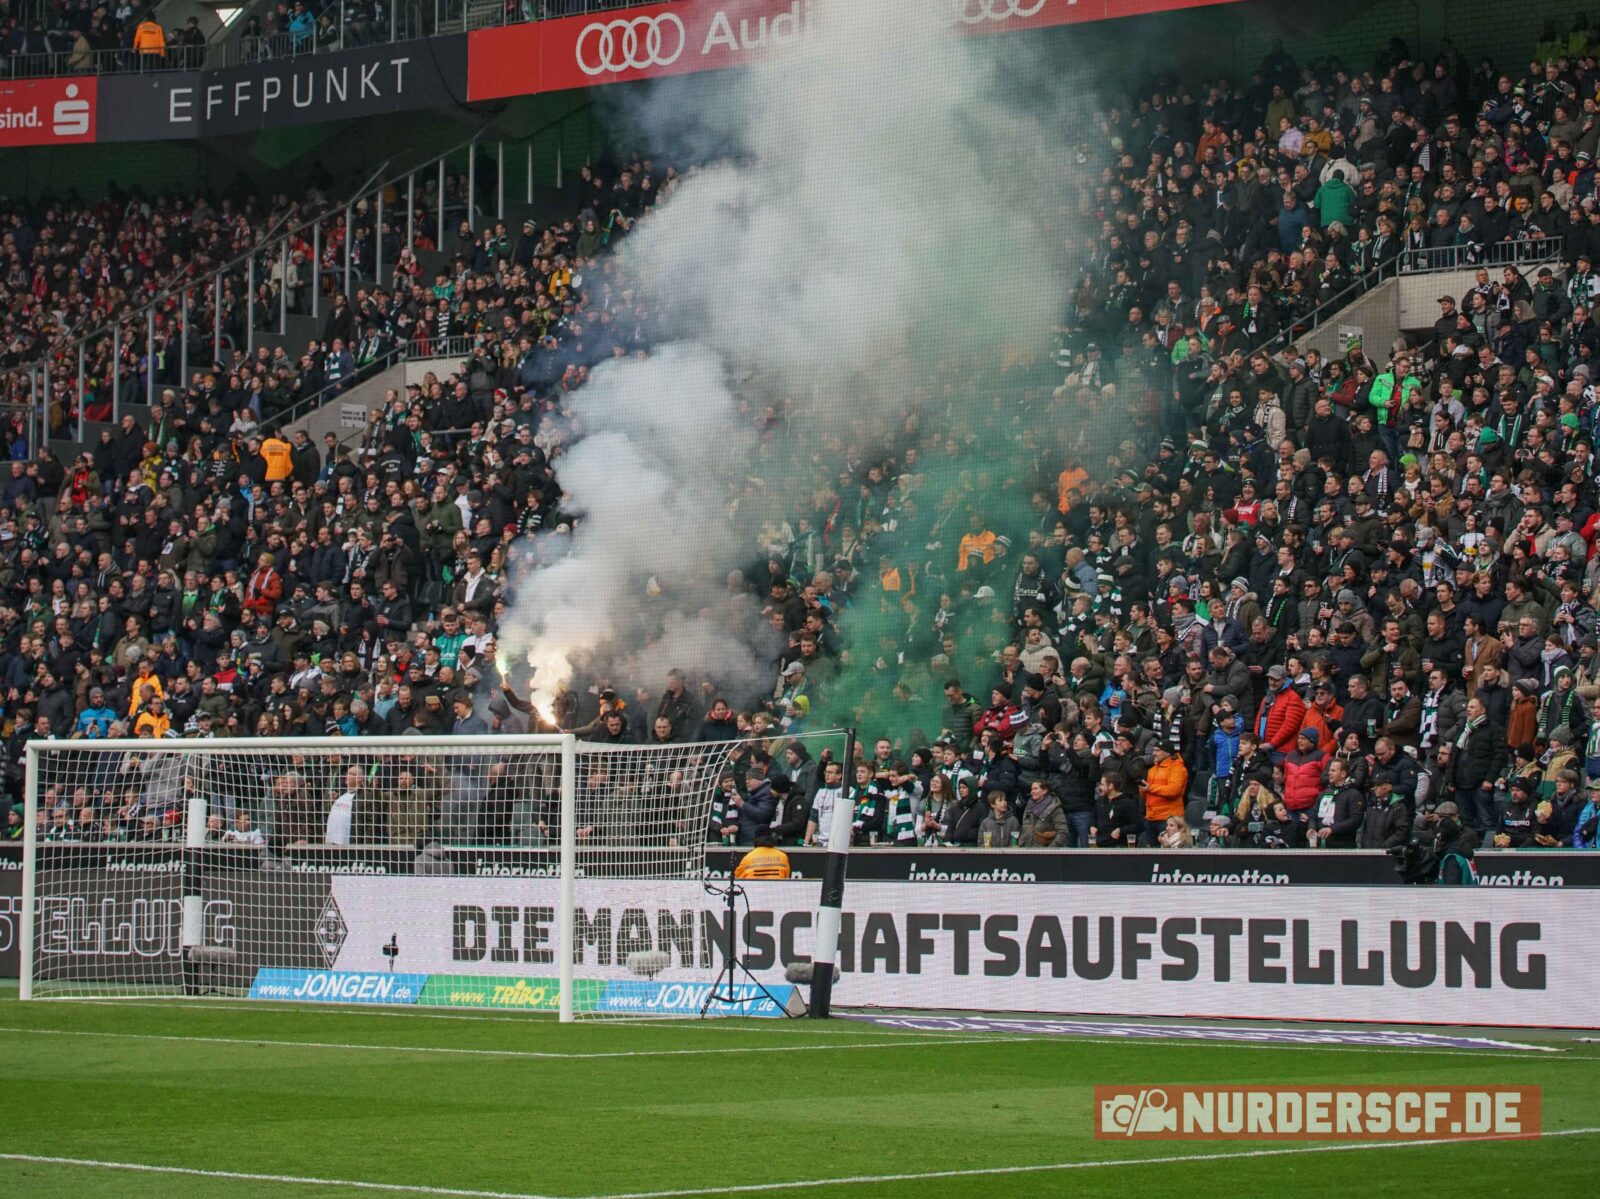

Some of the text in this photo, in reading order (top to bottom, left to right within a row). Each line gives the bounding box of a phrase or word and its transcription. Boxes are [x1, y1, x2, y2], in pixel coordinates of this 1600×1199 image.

[169, 57, 410, 123] EFFPUNKT
[106, 855, 187, 872] interwette
[292, 862, 386, 874] nterwetten
[476, 858, 585, 876] interwettn
[685, 861, 803, 880] intern
[908, 863, 1036, 881] interwetten
[1151, 864, 1290, 884] interwetten
[452, 905, 554, 963] DIE
